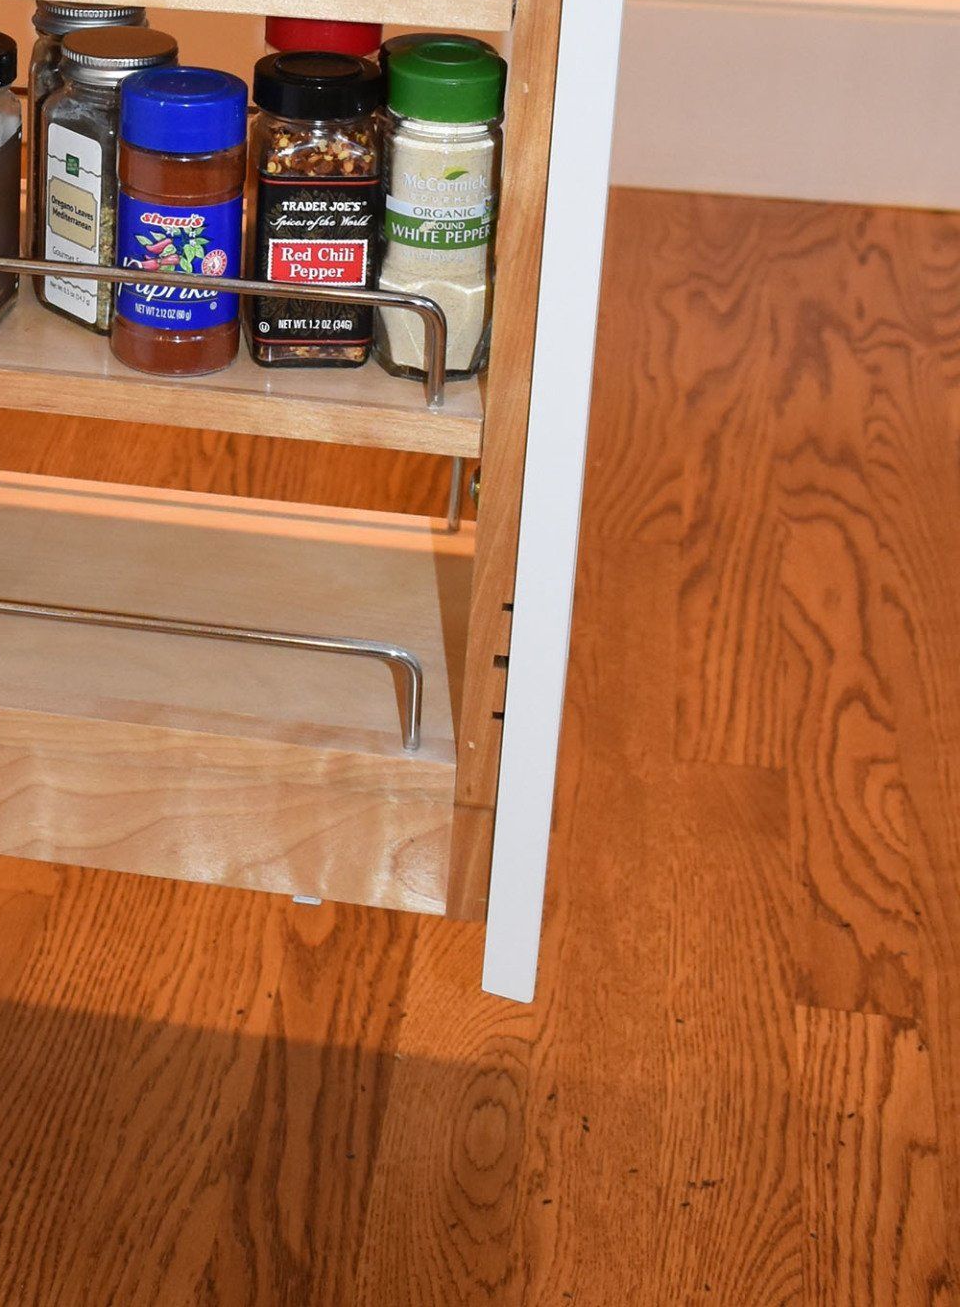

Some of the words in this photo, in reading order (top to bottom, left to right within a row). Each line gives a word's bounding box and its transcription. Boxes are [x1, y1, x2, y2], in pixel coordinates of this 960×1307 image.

[404, 173, 488, 192] McCormick
[51, 195, 74, 213] Oregano
[74, 205, 94, 222] Leaves
[282, 202, 327, 211] TRADER
[413, 206, 476, 218] ORGANIC
[52, 208, 92, 232] Mediterranean
[270, 215, 305, 231] Spices
[307, 215, 321, 231] of
[321, 215, 336, 227] the
[340, 215, 373, 227] World
[392, 222, 440, 244] WHITE
[445, 224, 491, 244] PEPPER
[281, 247, 312, 262] Red
[317, 247, 355, 262] Chili
[289, 264, 345, 280] Pepper
[278, 320, 292, 329] NET
[309, 320, 320, 329] 1.2
[321, 320, 331, 330] OZ
[333, 319, 353, 331] (34G)
